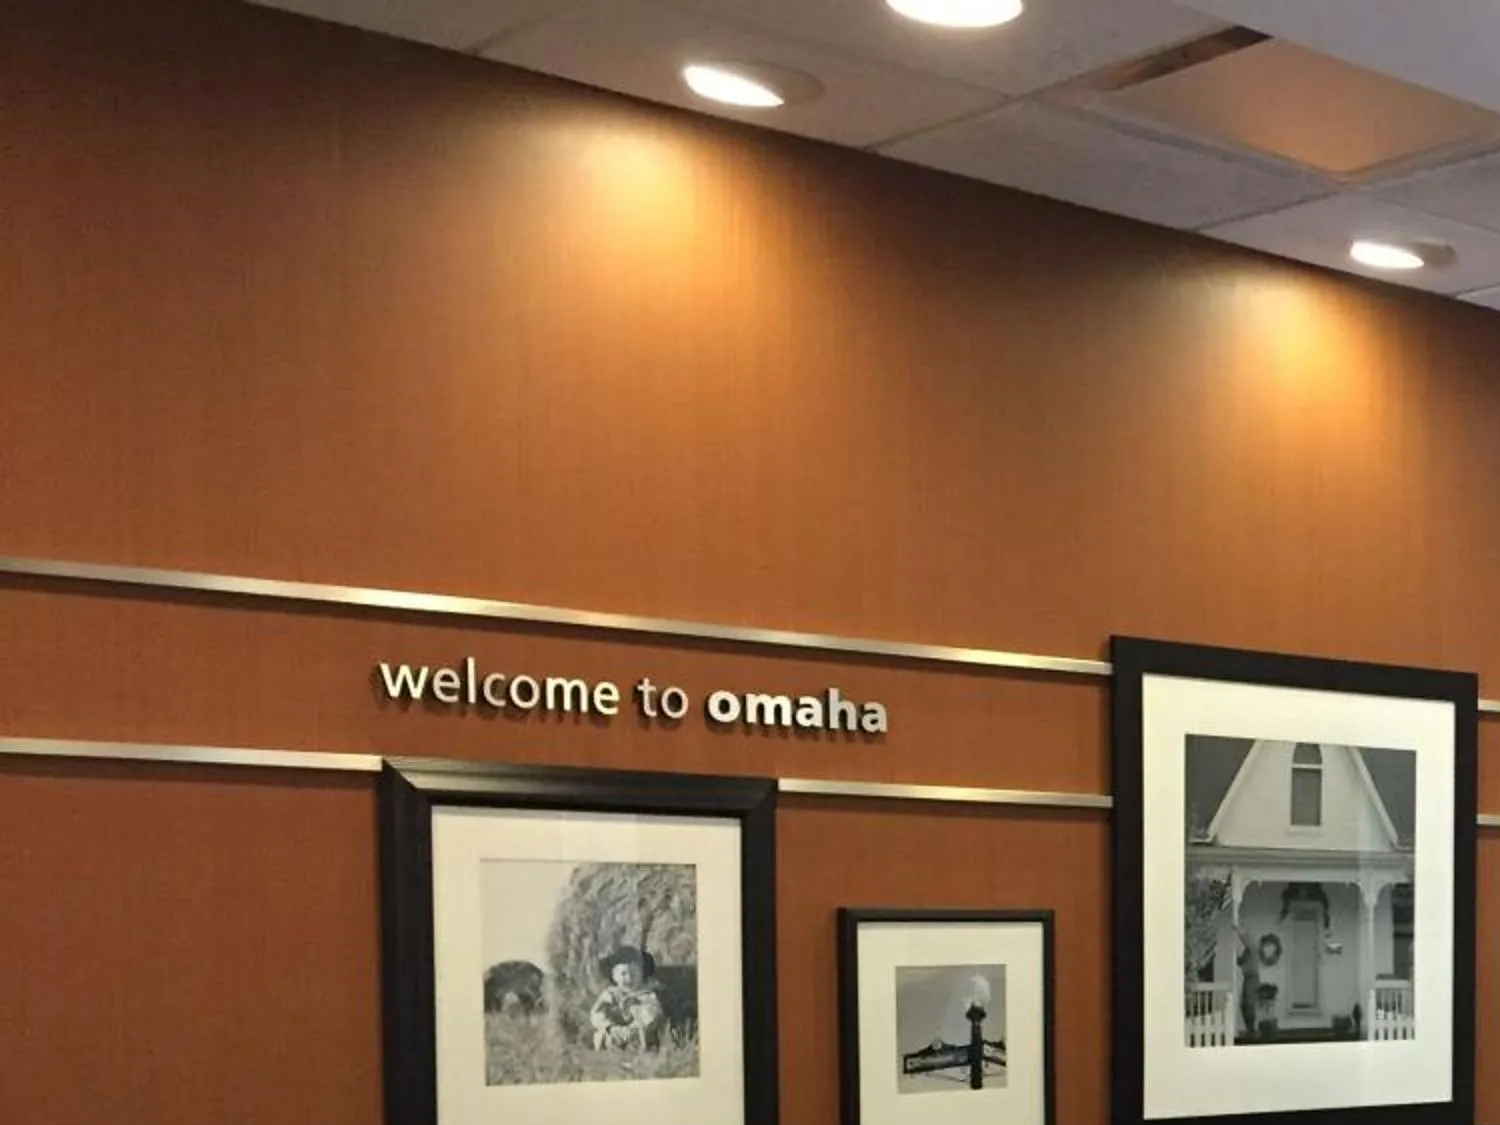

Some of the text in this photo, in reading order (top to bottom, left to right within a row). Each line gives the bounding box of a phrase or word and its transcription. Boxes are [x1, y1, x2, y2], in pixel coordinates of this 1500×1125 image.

[379, 657, 888, 732] welcome to omaha
